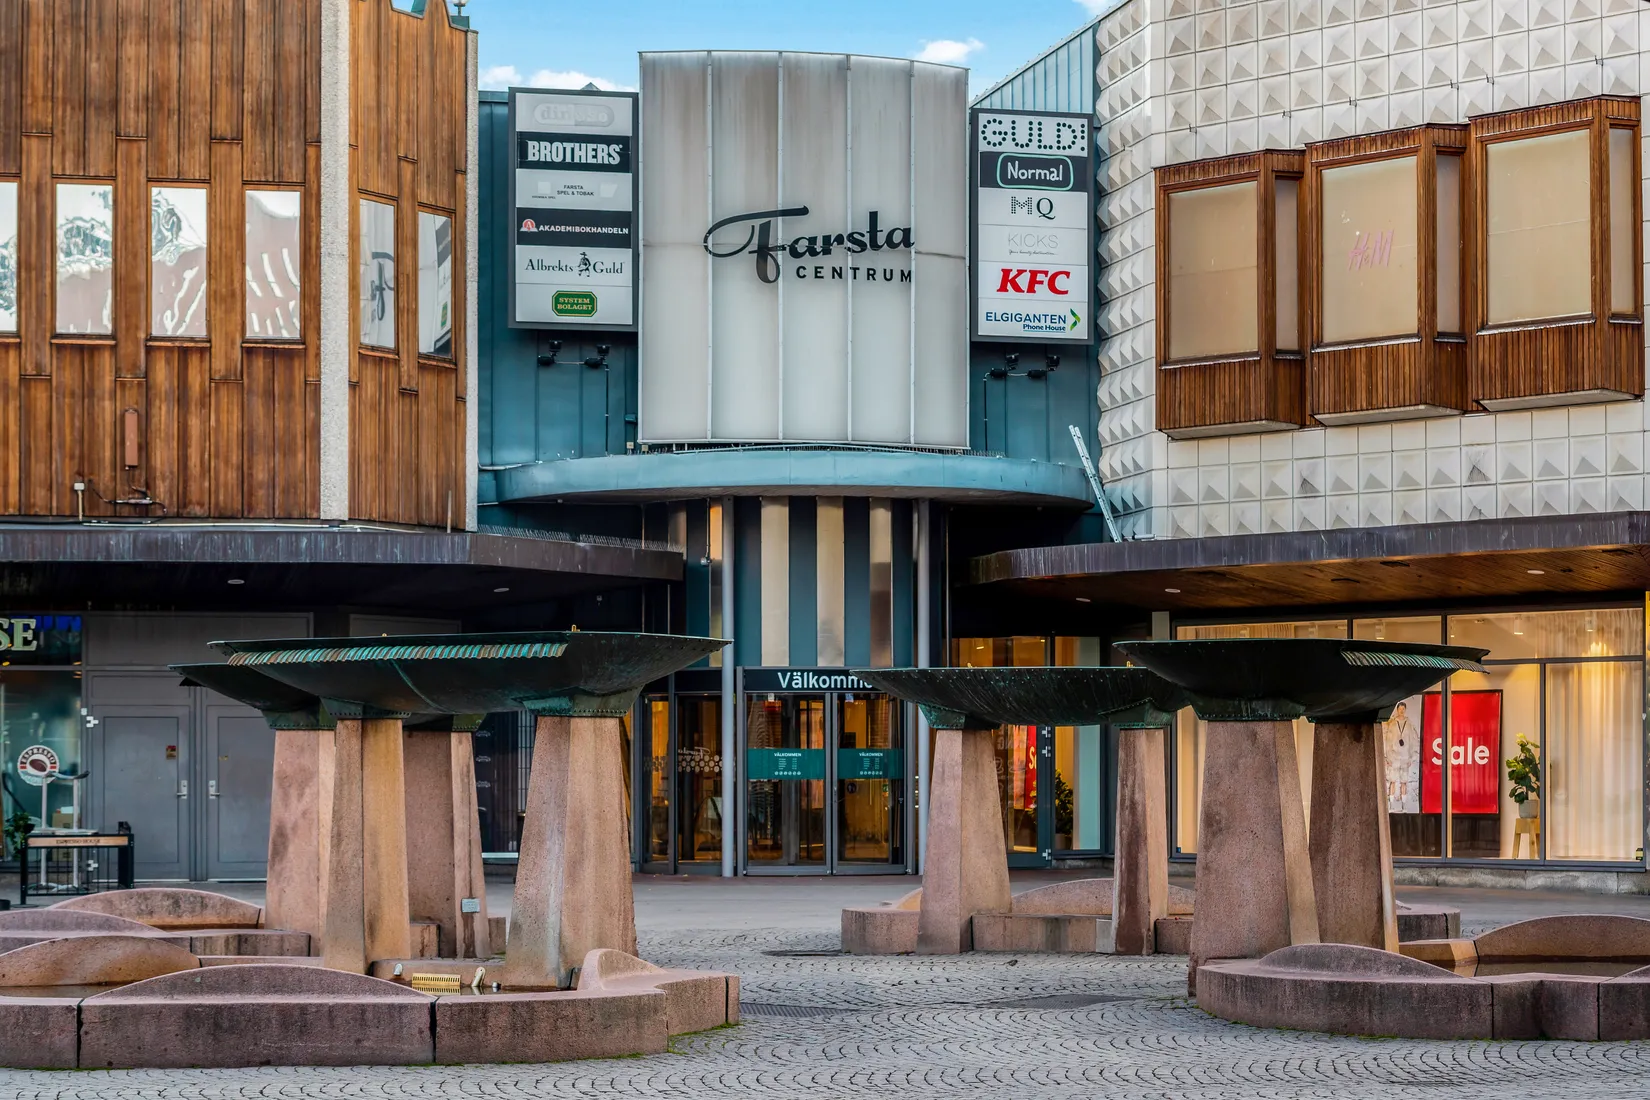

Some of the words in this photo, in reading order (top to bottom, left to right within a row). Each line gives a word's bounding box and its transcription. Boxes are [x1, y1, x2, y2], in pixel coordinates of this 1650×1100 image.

[981, 118, 1085, 151] GULD!
[526, 140, 621, 165] BROTHERS
[1007, 160, 1063, 182] Normal
[1010, 195, 1056, 220] MQ
[539, 225, 629, 235] AKADEMIBOKHANDELN
[703, 205, 915, 284] Farsta
[1008, 233, 1059, 249] KICKS
[525, 258, 574, 273] Albrekts
[592, 260, 624, 275] Guld
[795, 266, 912, 283] CENTRUM
[996, 268, 1071, 296] KFC
[985, 312, 1067, 325] ELGIGANTEN
[1022, 323, 1044, 331] Phone
[1045, 324, 1066, 332] House
[20, 746, 57, 764] ESPRESSO
[1431, 736, 1490, 766] Sale
